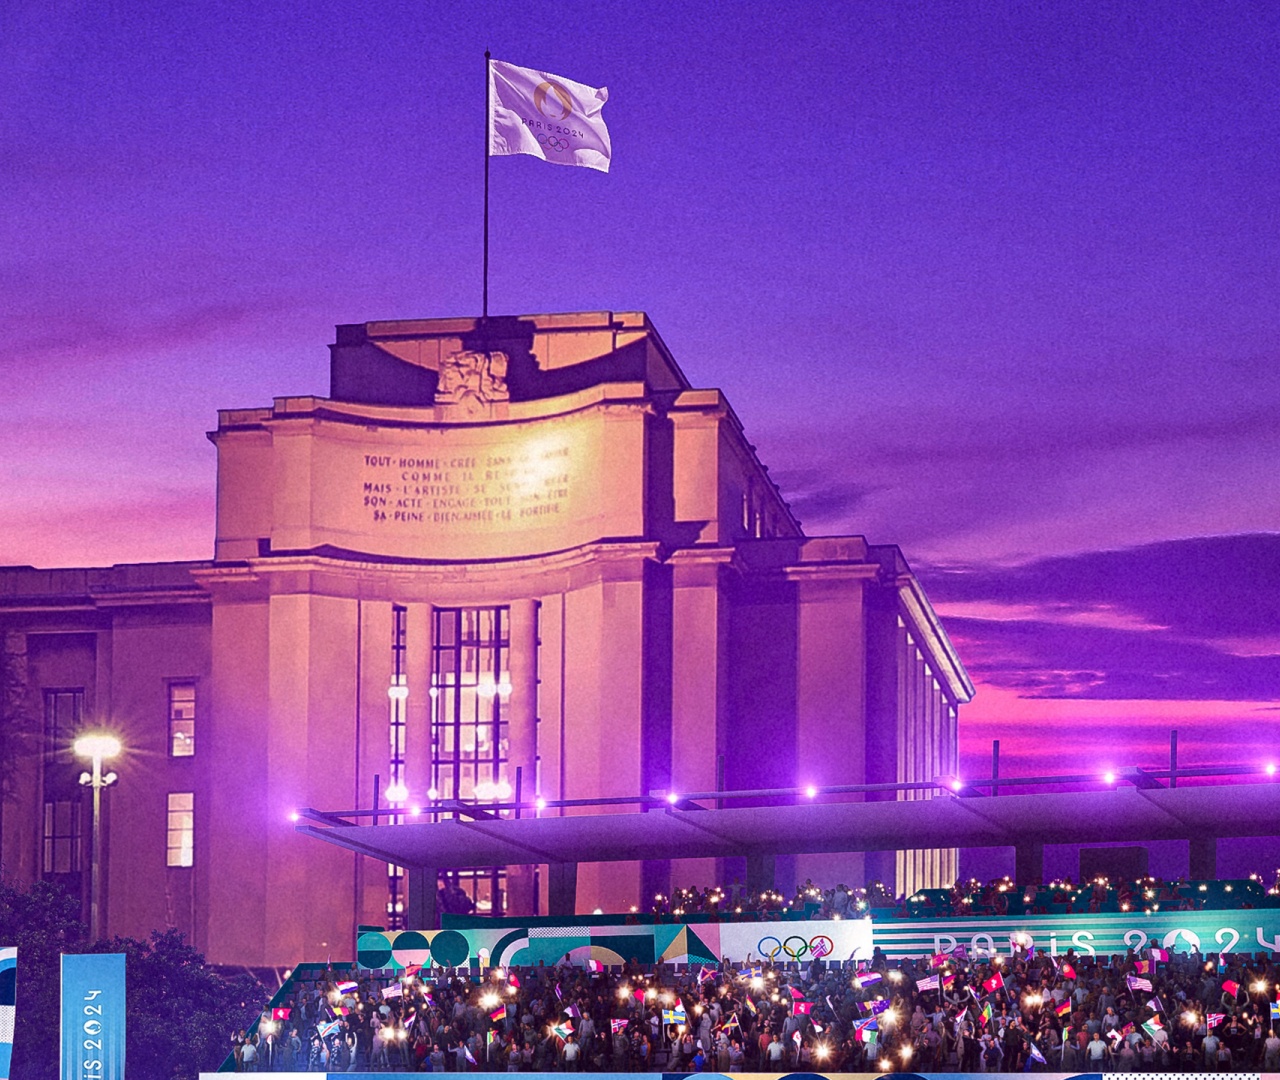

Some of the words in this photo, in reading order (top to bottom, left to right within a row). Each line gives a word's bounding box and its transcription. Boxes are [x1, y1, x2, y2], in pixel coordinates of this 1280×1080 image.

[556, 125, 584, 138] 2024
[363, 455, 391, 467] TOUT
[399, 458, 439, 469] HOMME
[401, 471, 449, 482] COMME
[363, 482, 392, 494] MAIS
[363, 495, 387, 508] SON
[396, 498, 422, 509] ACTE
[373, 510, 387, 521] SA
[394, 511, 424, 522] PEINE
[83, 990, 102, 1050] 2024
